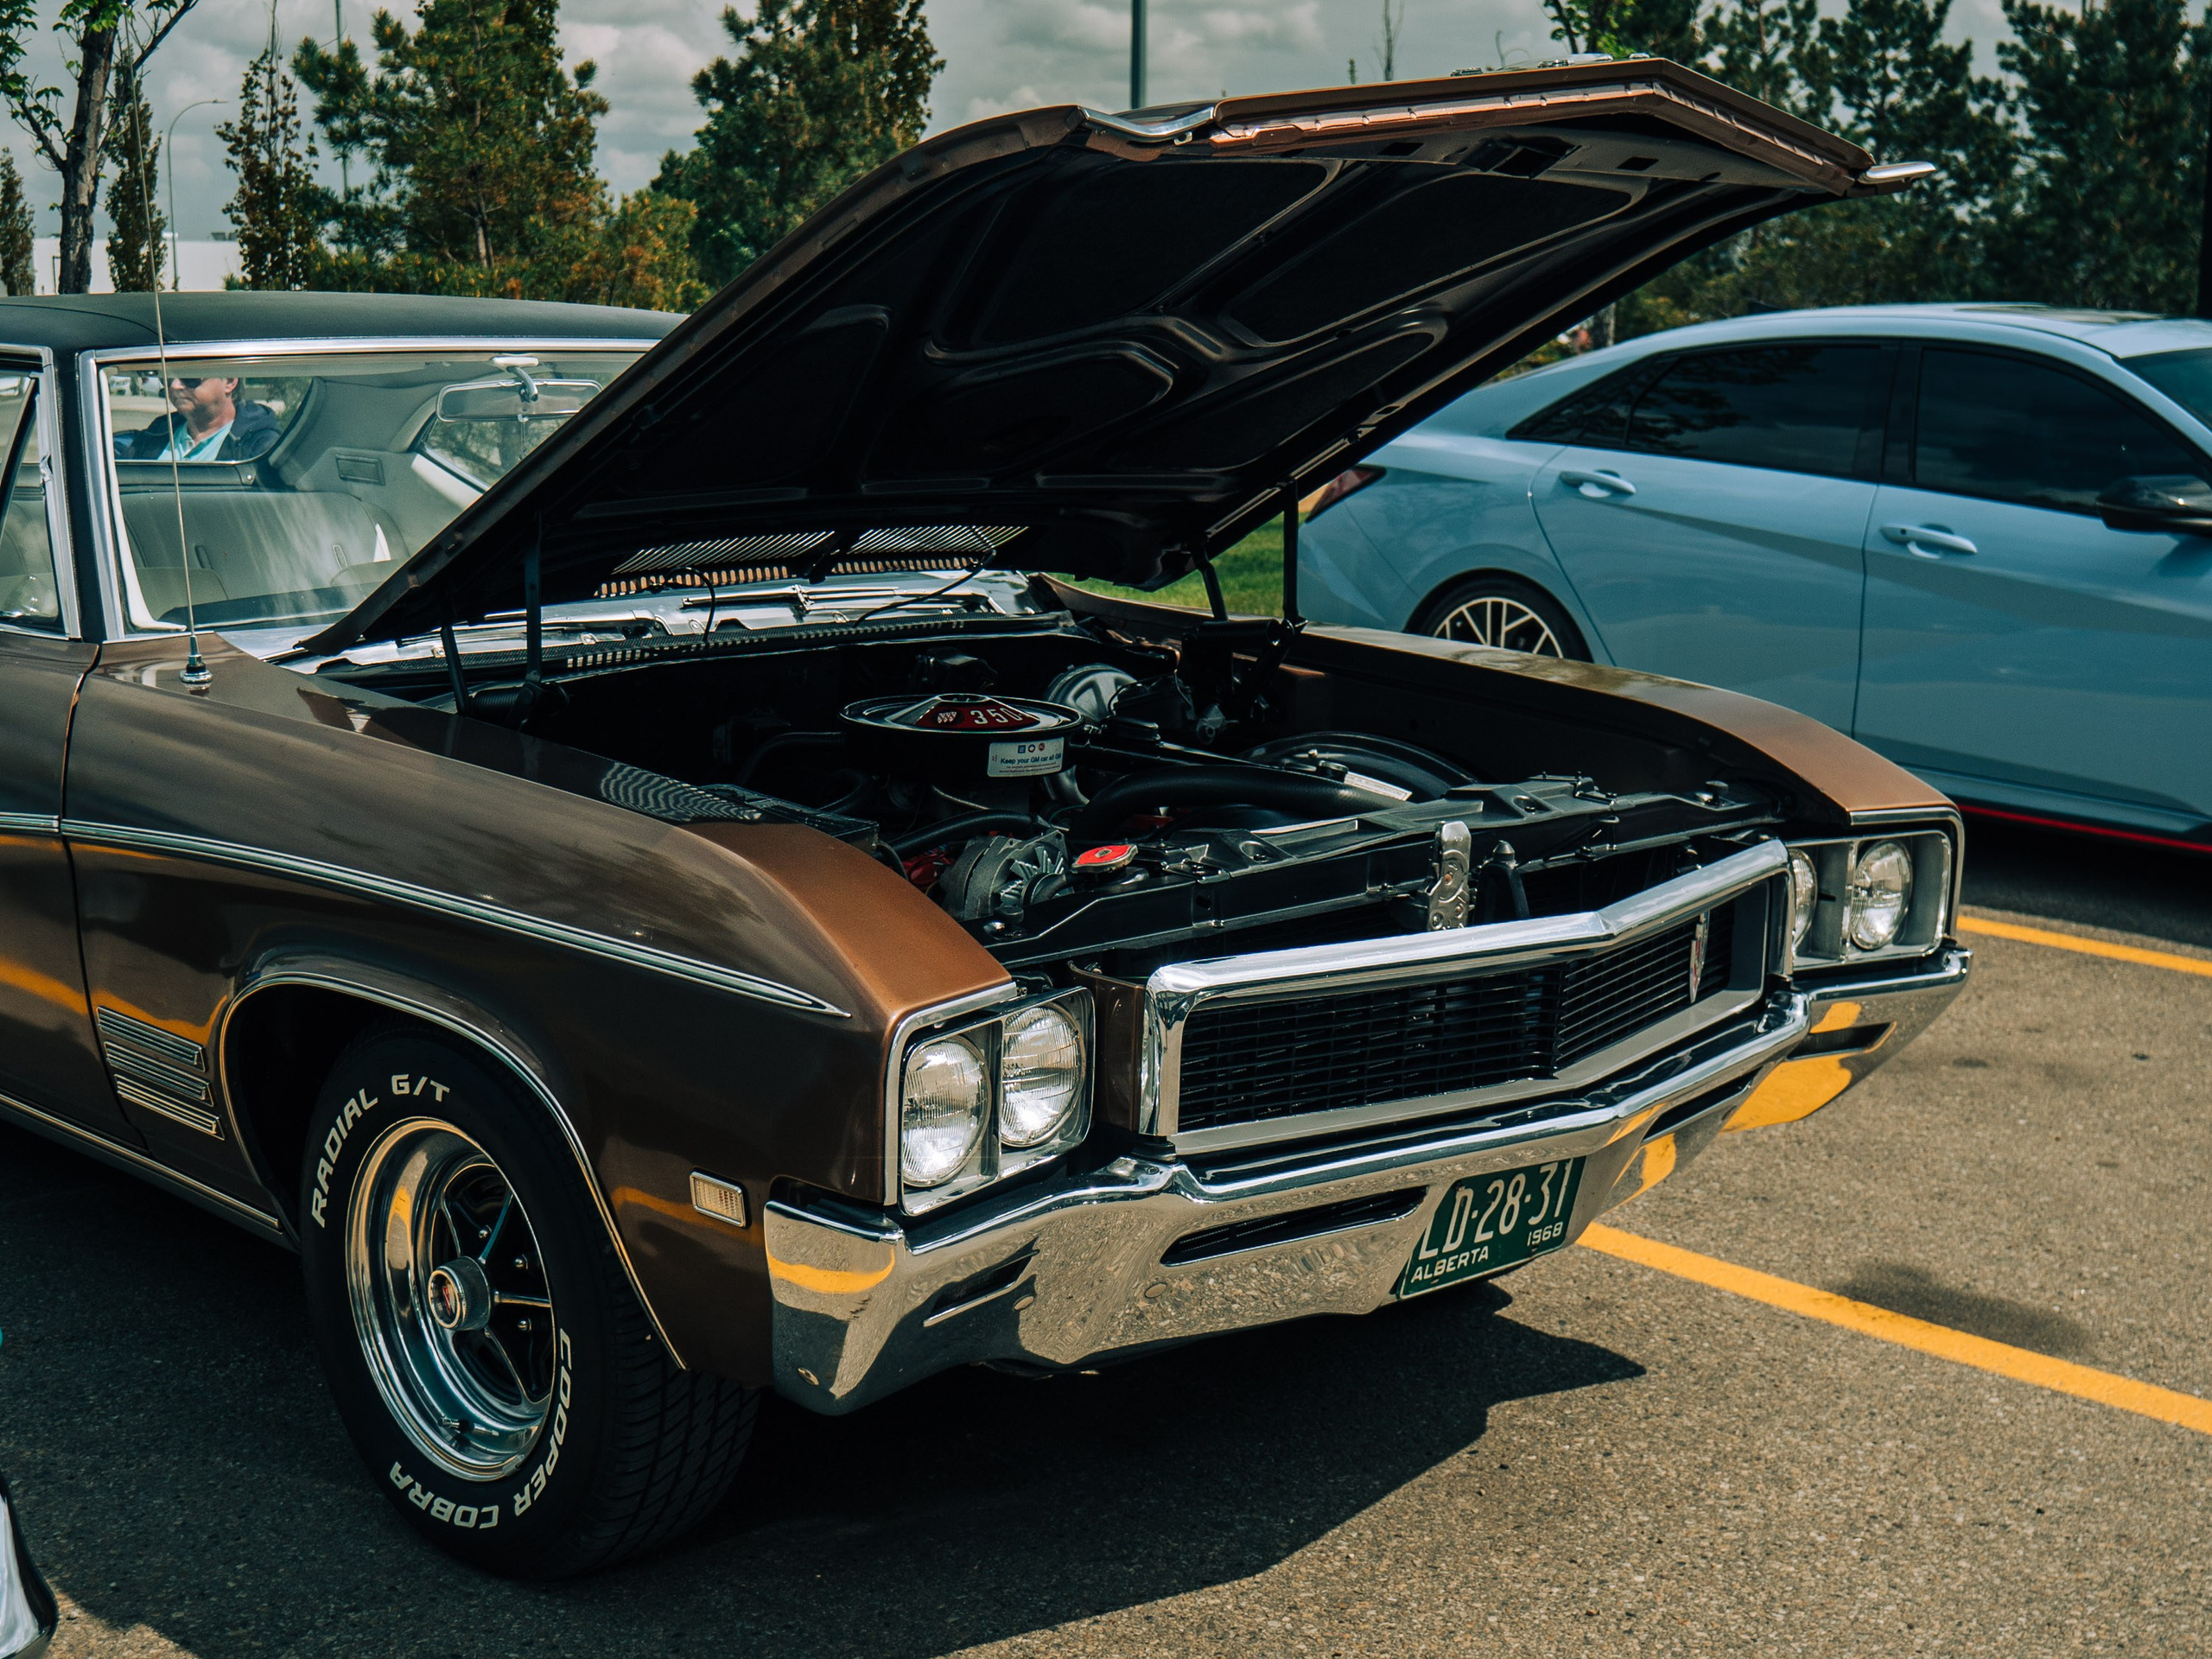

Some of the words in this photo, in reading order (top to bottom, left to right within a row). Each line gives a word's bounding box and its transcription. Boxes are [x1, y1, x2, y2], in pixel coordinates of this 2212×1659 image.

[311, 1088, 378, 1228] RADIAL
[391, 1074, 450, 1103] G/T
[1410, 1245, 1489, 1284] ALBERTA
[1527, 1221, 1564, 1247] 1968
[513, 1327, 573, 1518] COOPER
[389, 1460, 499, 1530] COBRA
